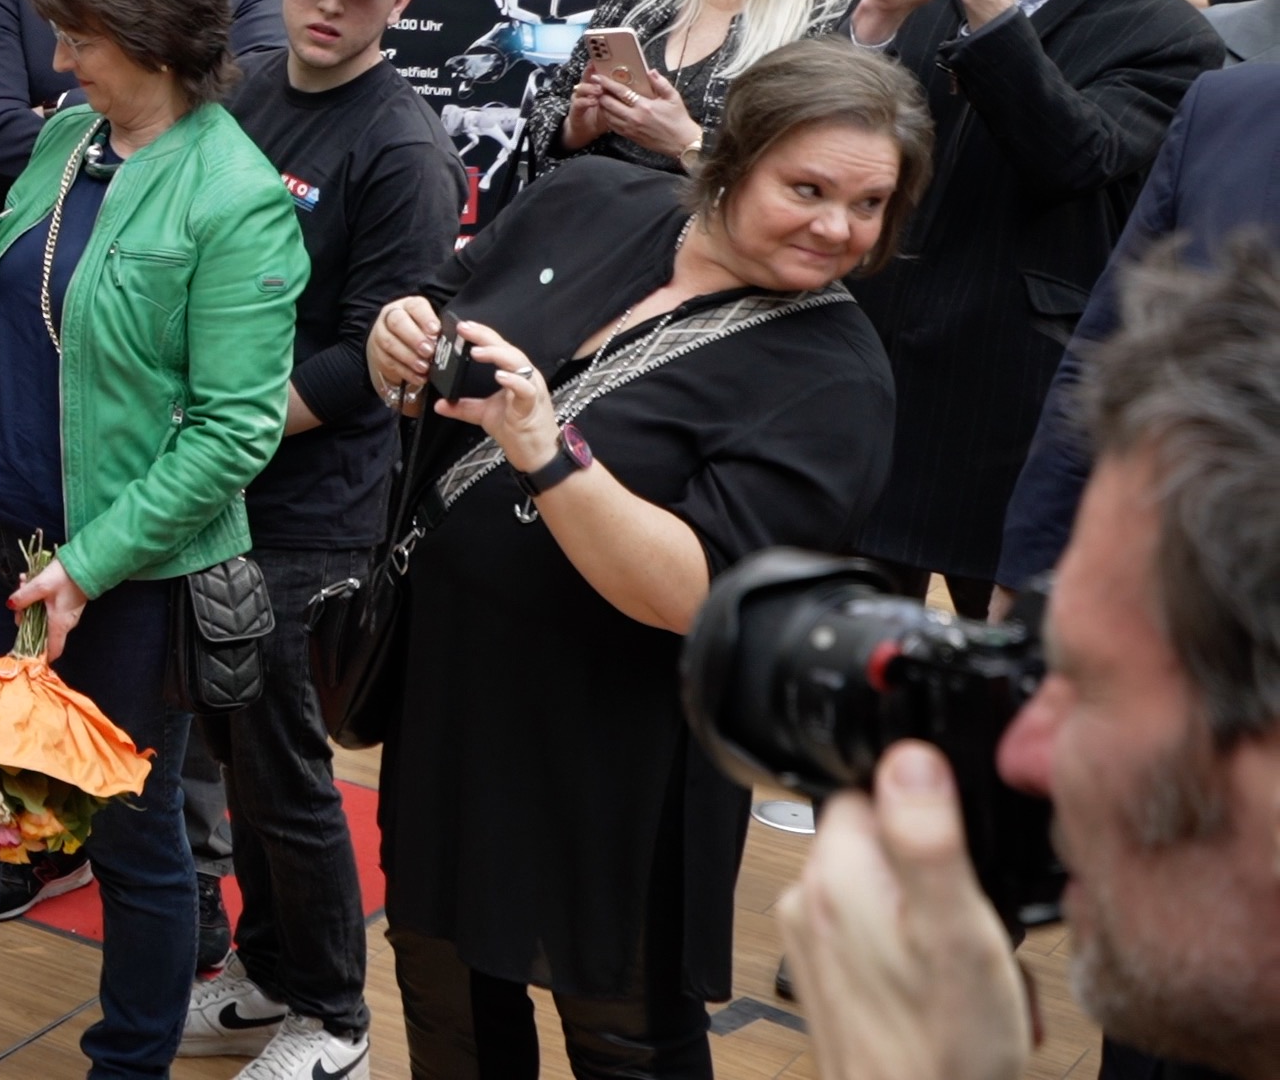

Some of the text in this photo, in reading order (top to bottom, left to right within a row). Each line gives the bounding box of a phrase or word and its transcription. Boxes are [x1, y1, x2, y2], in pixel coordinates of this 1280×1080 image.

[387, 18, 444, 32] 4:00 Uhr
[396, 66, 439, 79] stfield
[411, 84, 453, 97] ntrum
